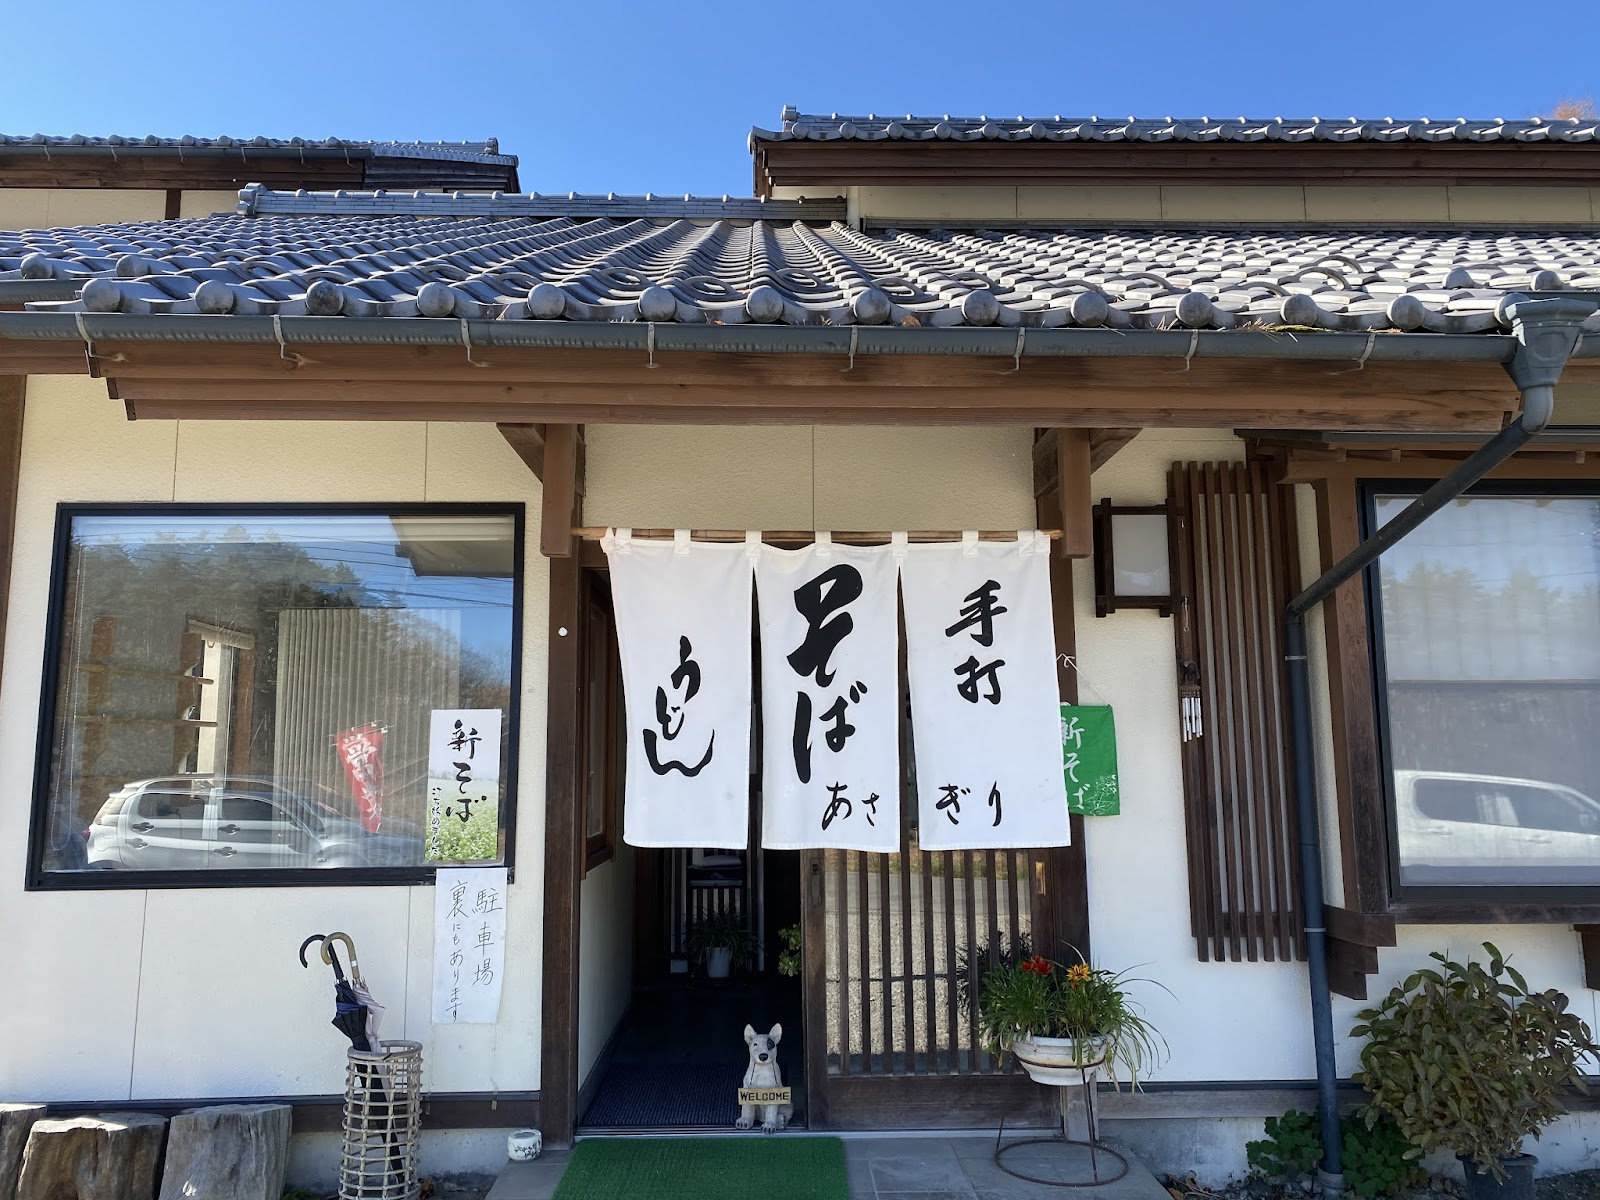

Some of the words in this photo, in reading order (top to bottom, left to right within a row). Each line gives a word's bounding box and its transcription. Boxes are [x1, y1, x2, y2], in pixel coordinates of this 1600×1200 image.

[786, 563, 868, 784] そば
[945, 579, 1007, 705] 手打
[643, 635, 714, 777] うどん
[1060, 716, 1090, 810] 新そば
[445, 719, 487, 823] 新そば
[445, 879, 468, 1023] 裏にもあります
[471, 887, 503, 986] 駐車場
[739, 1091, 790, 1102] WELCOME
